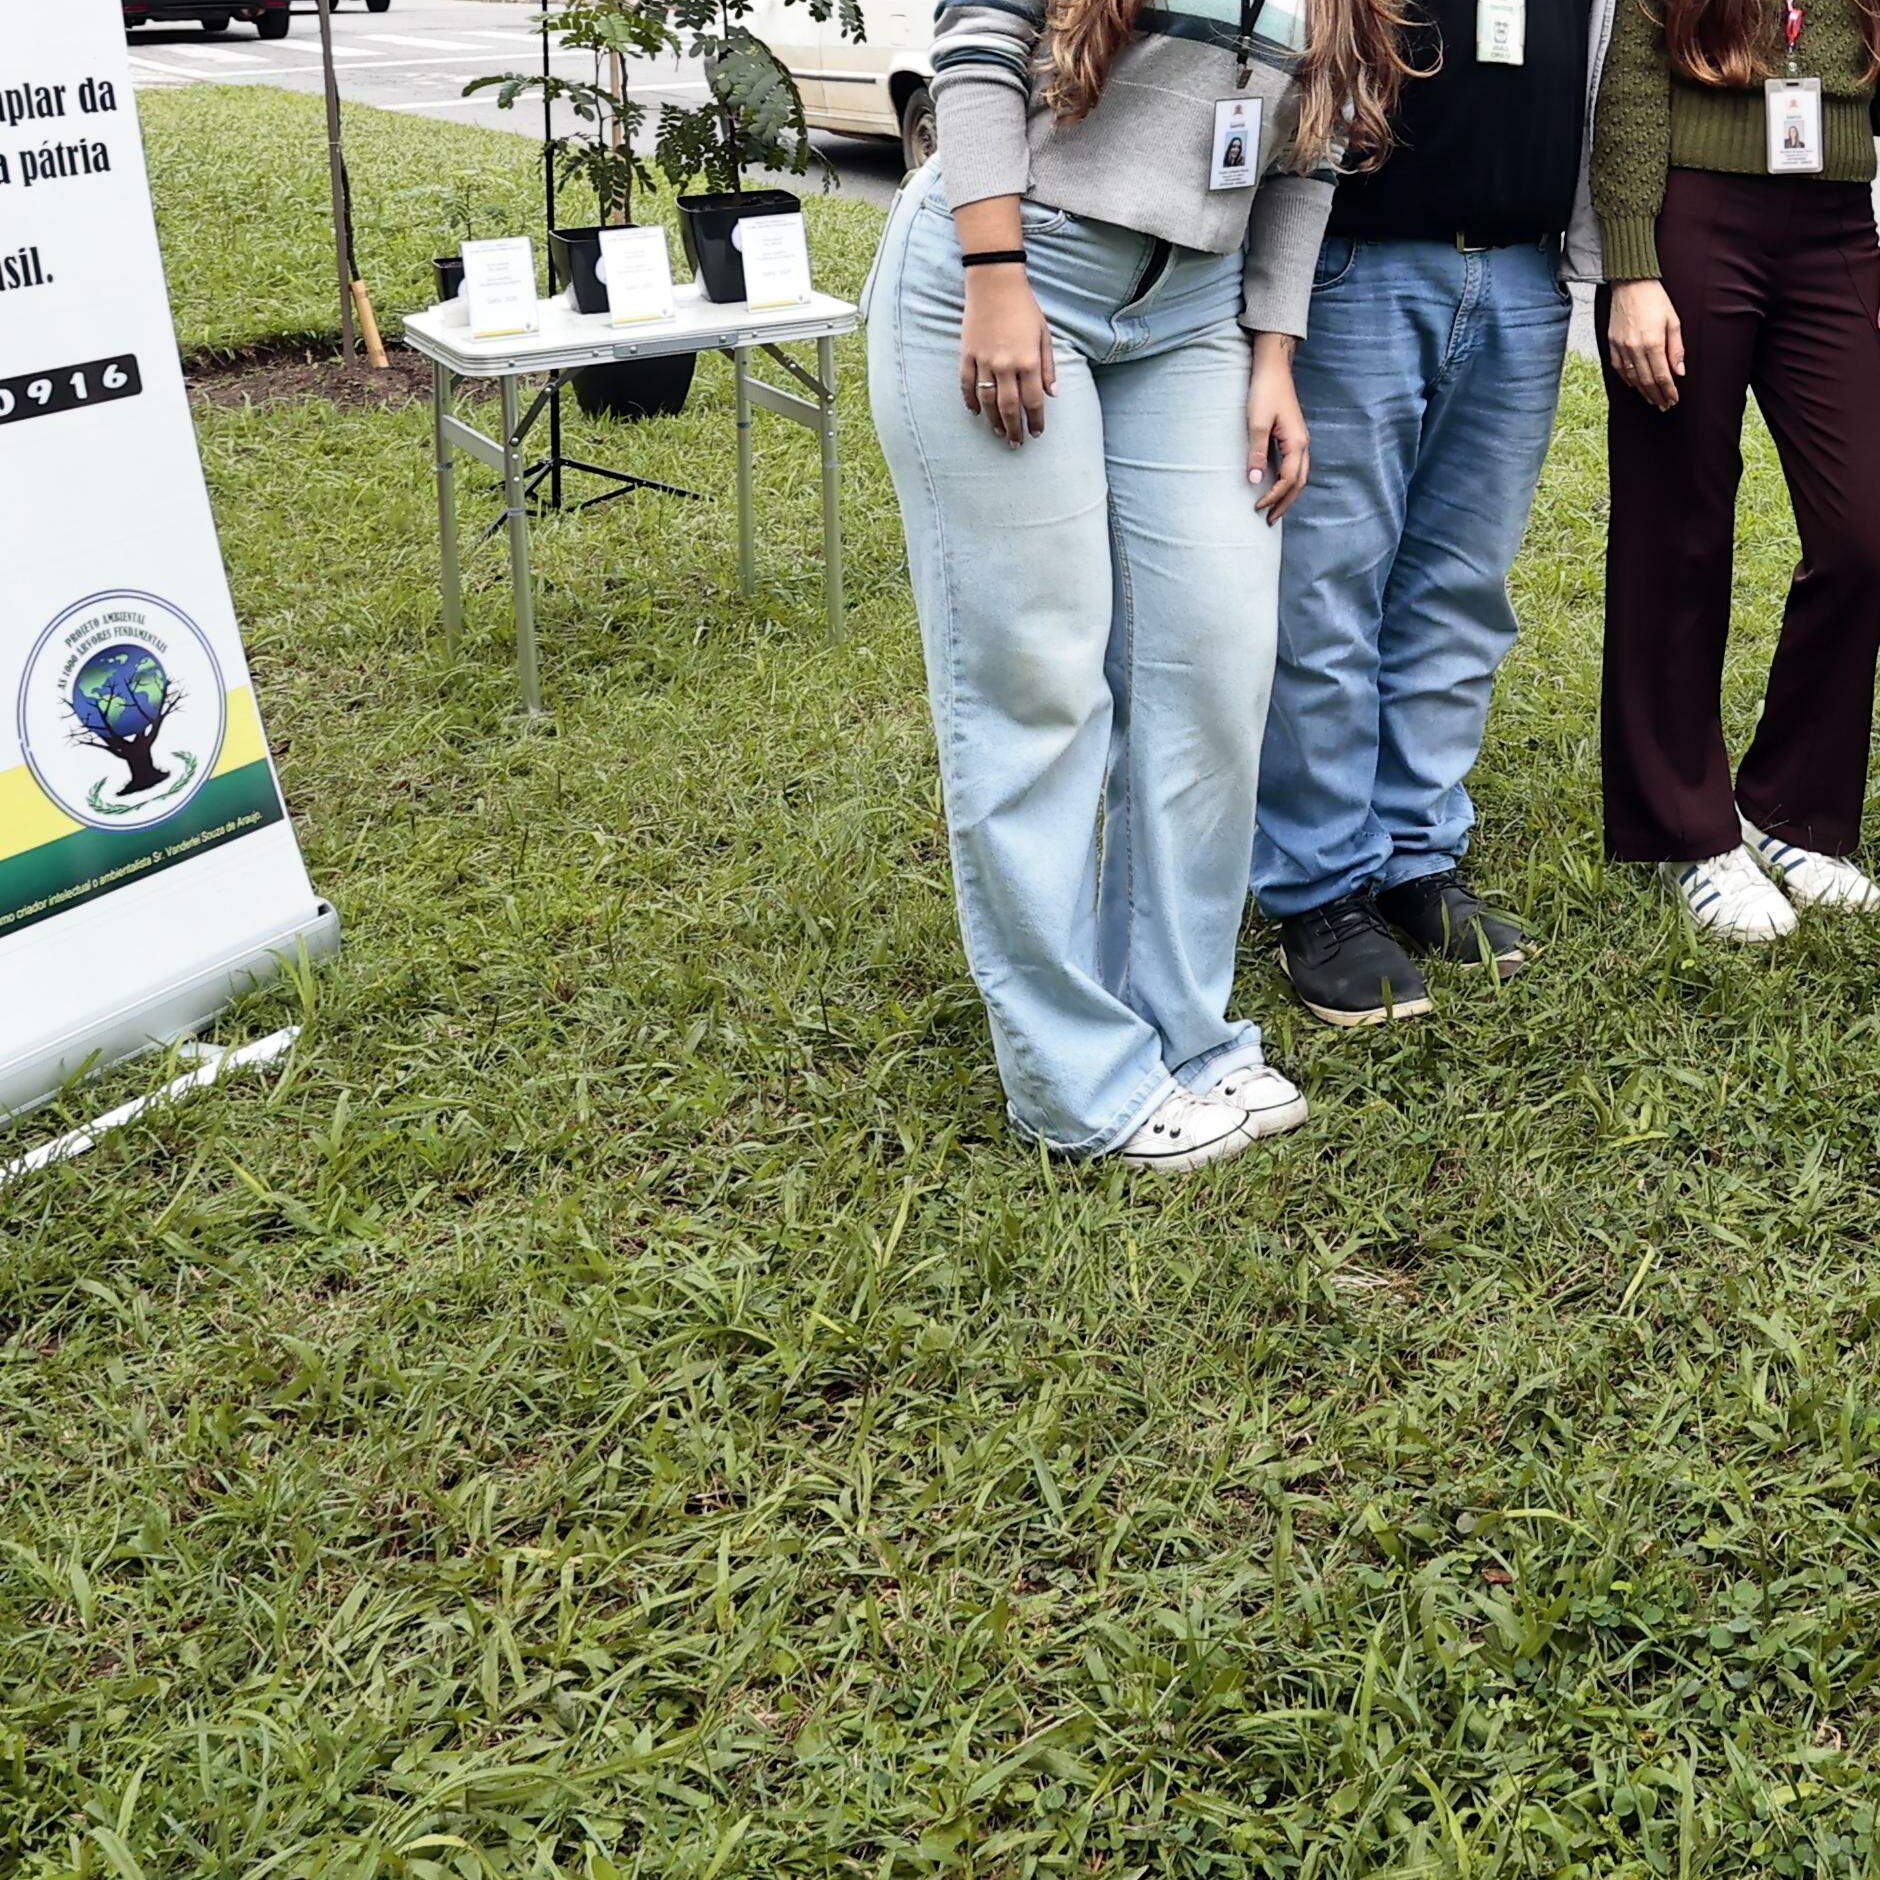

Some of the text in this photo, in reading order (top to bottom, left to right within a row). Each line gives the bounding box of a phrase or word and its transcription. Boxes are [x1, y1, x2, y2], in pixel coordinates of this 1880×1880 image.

[78, 77, 117, 114] da
[20, 138, 111, 187] pátria
[63, 654, 79, 677] 1000
[114, 626, 168, 654] FUNDAMENTAIS
[64, 611, 146, 648] PROJETO AMBIENTAL
[16, 899, 48, 919] criador
[48, 880, 92, 906] intelectual
[99, 856, 152, 886] ambientalista
[152, 851, 165, 863] Sr.
[201, 830, 226, 843] Souza
[226, 821, 236, 833] de
